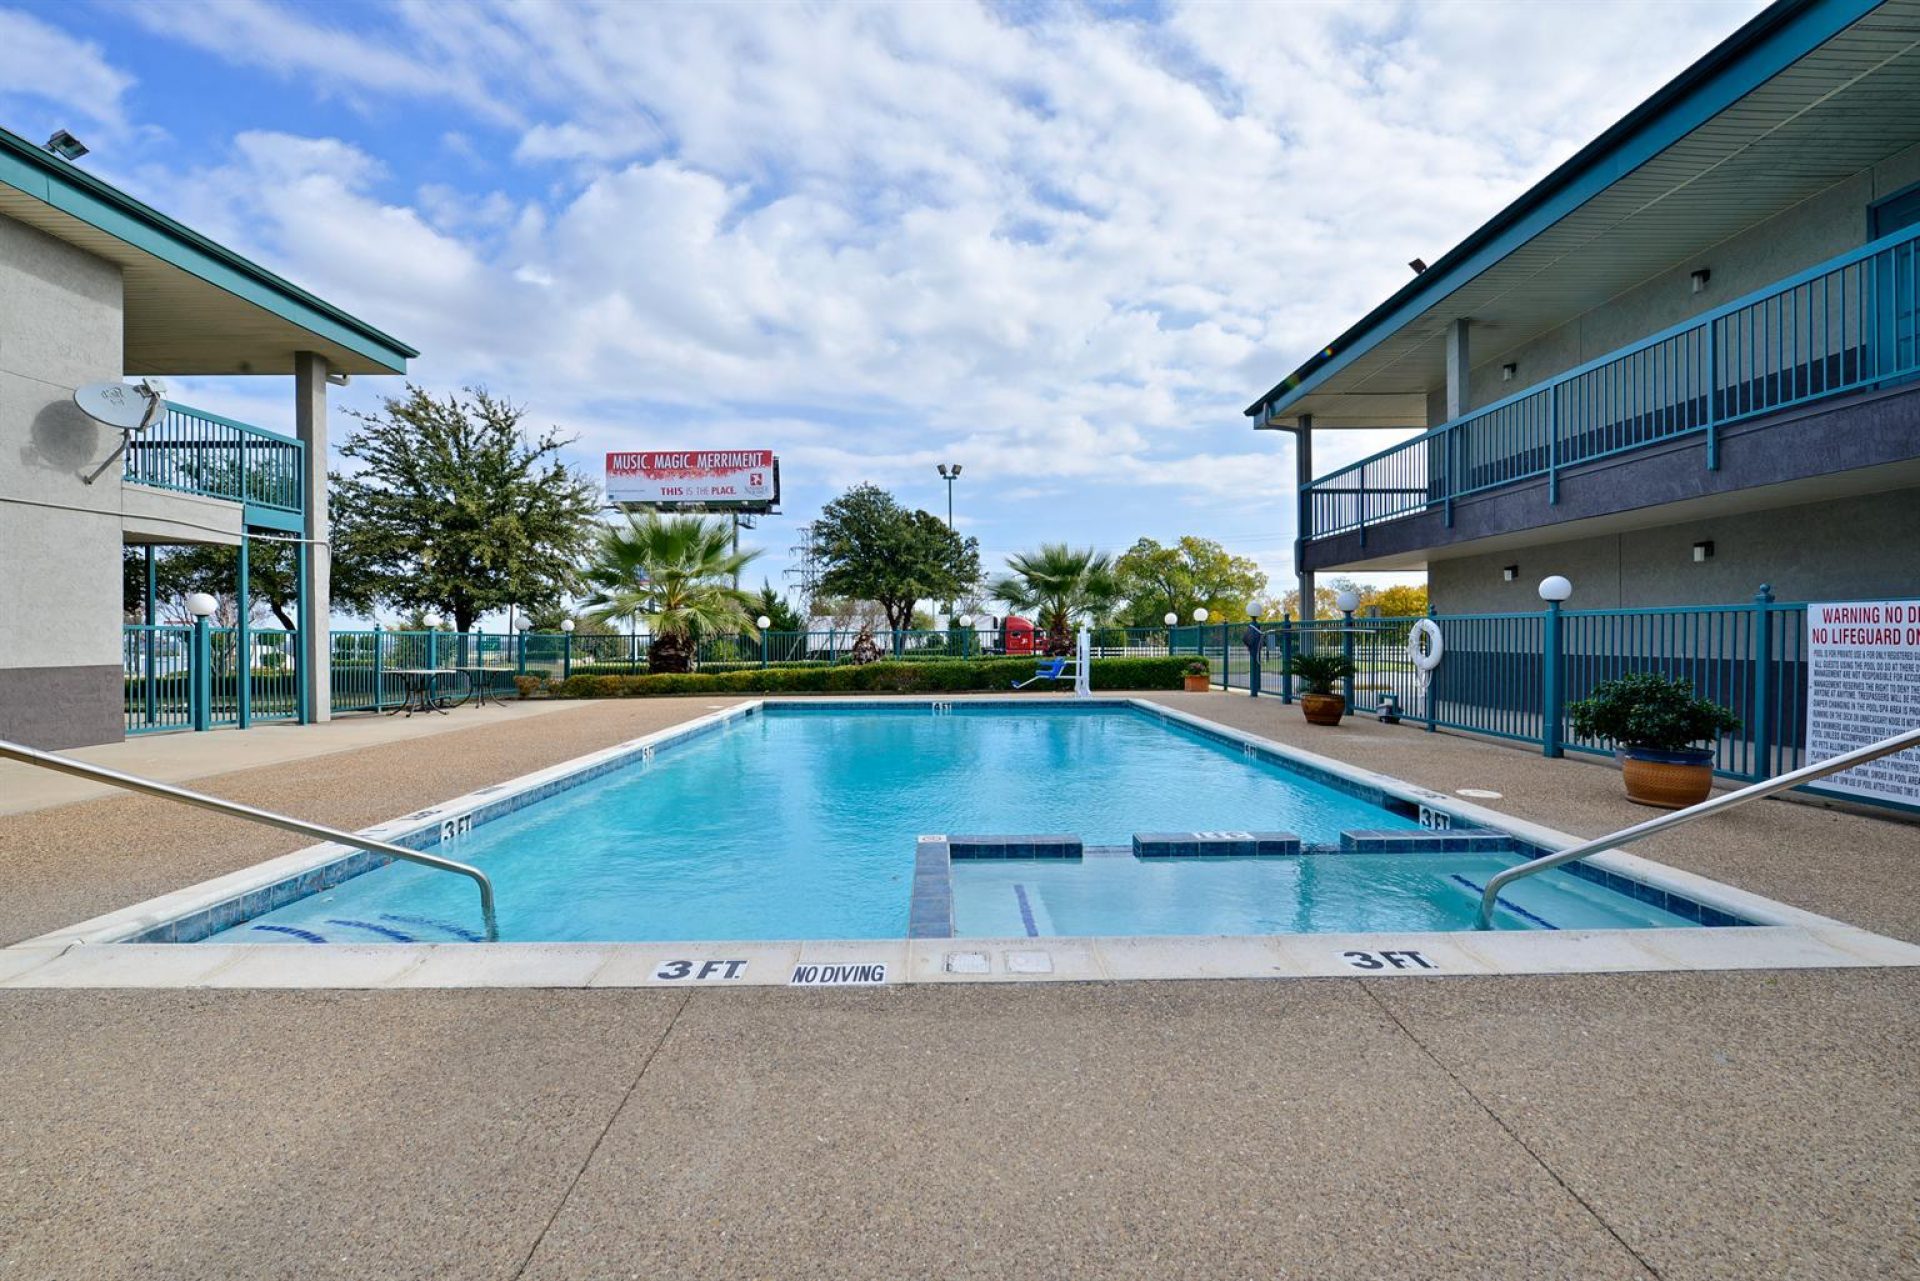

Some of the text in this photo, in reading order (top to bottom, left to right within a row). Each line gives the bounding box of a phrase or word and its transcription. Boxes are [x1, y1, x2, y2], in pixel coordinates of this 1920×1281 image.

[613, 452, 766, 469] MUSIC. MAGIC. MERRIMENT.
[661, 487, 683, 495] THIS
[1823, 607, 1880, 624] WARNING
[1885, 606, 1902, 623] NO
[1813, 628, 1827, 644] NO
[1832, 628, 1901, 645] LIFEGUARD
[1864, 661, 1875, 670] POOL
[444, 820, 454, 840] 3
[458, 814, 471, 835] FT
[1422, 808, 1449, 830] 3 FT
[1344, 951, 1384, 969] 3
[657, 960, 693, 979] 3
[792, 964, 884, 983] NO DIVING
